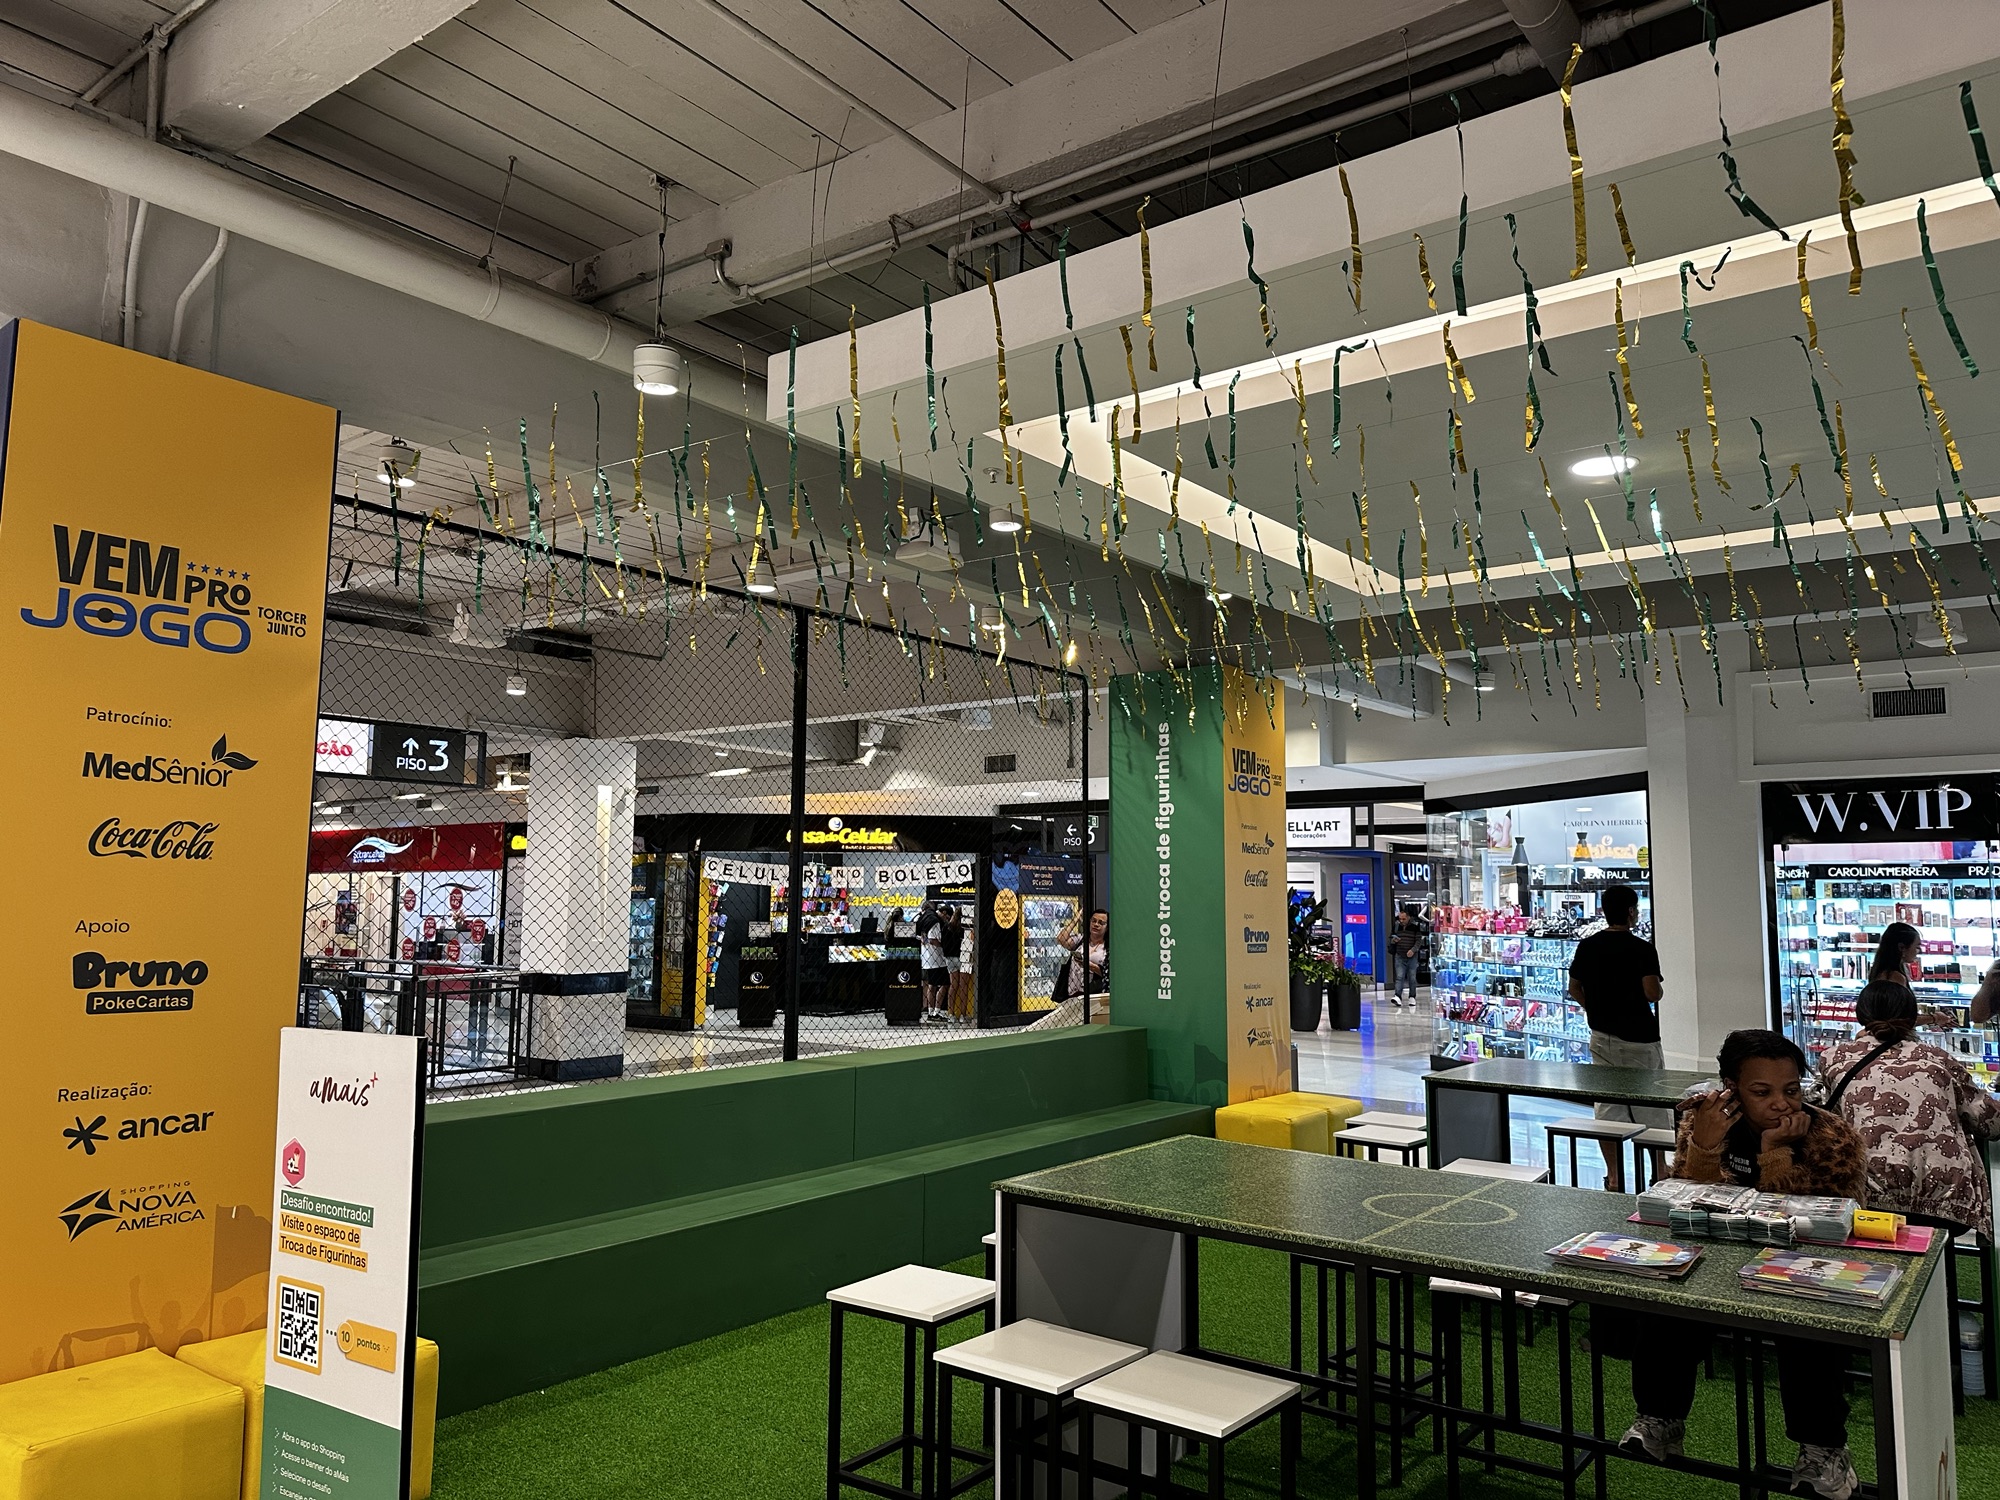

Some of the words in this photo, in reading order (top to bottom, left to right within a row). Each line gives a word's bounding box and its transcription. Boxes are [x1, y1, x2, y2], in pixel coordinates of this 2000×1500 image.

[53, 524, 180, 601] VEM
[184, 574, 251, 616] PRO
[20, 587, 251, 655] JOGO
[257, 606, 308, 625] TORCER
[266, 621, 307, 638] JUNTO
[87, 706, 172, 729] Patrocínio:
[396, 756, 427, 771] PISO
[428, 739, 449, 772] 3
[1232, 747, 1256, 775] VEM
[82, 751, 232, 787] MedSênior
[1154, 722, 1175, 830] figurinhas
[1256, 763, 1270, 778] PRO
[1228, 773, 1271, 797] JOGO
[1792, 788, 1972, 833] W.VIP
[88, 817, 220, 860] Coca-Cola
[1286, 820, 1341, 832] ELL'ART
[1063, 837, 1082, 846] PISO
[1155, 833, 1171, 860] de
[708, 859, 814, 884] CELULR
[836, 869, 861, 879] NO
[878, 863, 971, 884] BOLETO
[1398, 862, 1431, 885] LUPO
[1606, 870, 1629, 879] PAUL
[1828, 866, 1885, 877] CAROLINA
[1886, 866, 1939, 877] HERRERA
[1968, 865, 2000, 877] PRAD
[1157, 863, 1171, 920] troca
[75, 919, 130, 937] Apoio
[1243, 926, 1269, 942] Bruno
[72, 951, 209, 989] Bruno
[1157, 923, 1176, 1000] Espaço
[93, 994, 189, 1010] PokeCartas
[1255, 997, 1274, 1007] ancar
[58, 1082, 152, 1102] Realização:
[118, 1111, 214, 1140] ancar
[121, 1181, 191, 1195] SHOPPING
[119, 1191, 196, 1213] NOVA
[282, 1192, 314, 1211] Desafio
[315, 1203, 371, 1223] encontrado!
[115, 1209, 205, 1233] AMÉRICA
[281, 1213, 305, 1231] Visite
[306, 1222, 312, 1233] o
[313, 1224, 346, 1241] espaço
[347, 1229, 360, 1243] de
[280, 1235, 304, 1253] Troca
[306, 1242, 318, 1256] de
[319, 1244, 366, 1268] Figurinhas
[341, 1330, 350, 1343] 10
[356, 1336, 381, 1352] pontos
[282, 1431, 295, 1443] Abra
[300, 1440, 311, 1450] app
[311, 1442, 319, 1452] do
[319, 1444, 345, 1464] Shopping
[281, 1449, 301, 1463] Acesse
[305, 1458, 325, 1472] banner
[324, 1466, 333, 1476] do
[280, 1467, 307, 1485] Selecione
[311, 1480, 332, 1495] desafio
